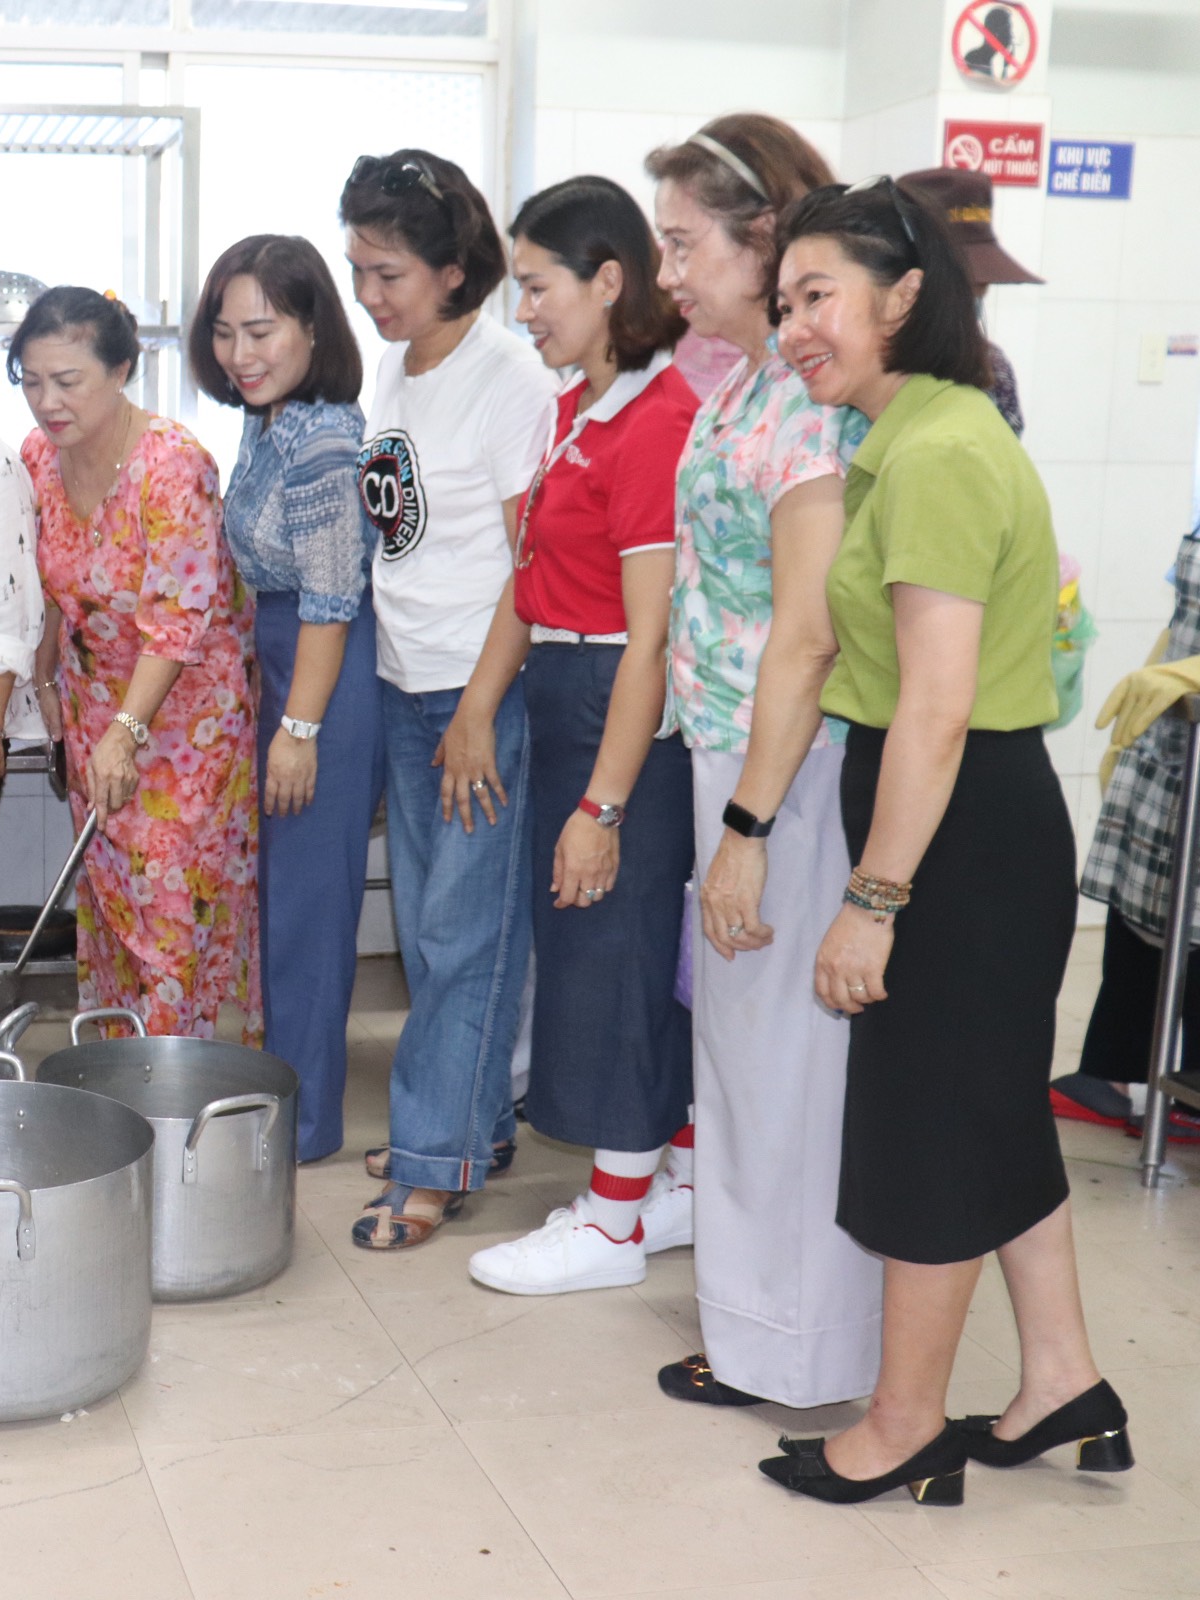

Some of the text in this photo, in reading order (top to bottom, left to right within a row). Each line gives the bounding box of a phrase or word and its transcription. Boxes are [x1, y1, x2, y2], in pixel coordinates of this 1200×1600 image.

[989, 133, 1034, 154] CẤM
[984, 157, 1039, 177] HÚT THUỐC
[1057, 146, 1112, 168] KHU VỰC
[1054, 168, 1111, 193] CHẾ BIẾN
